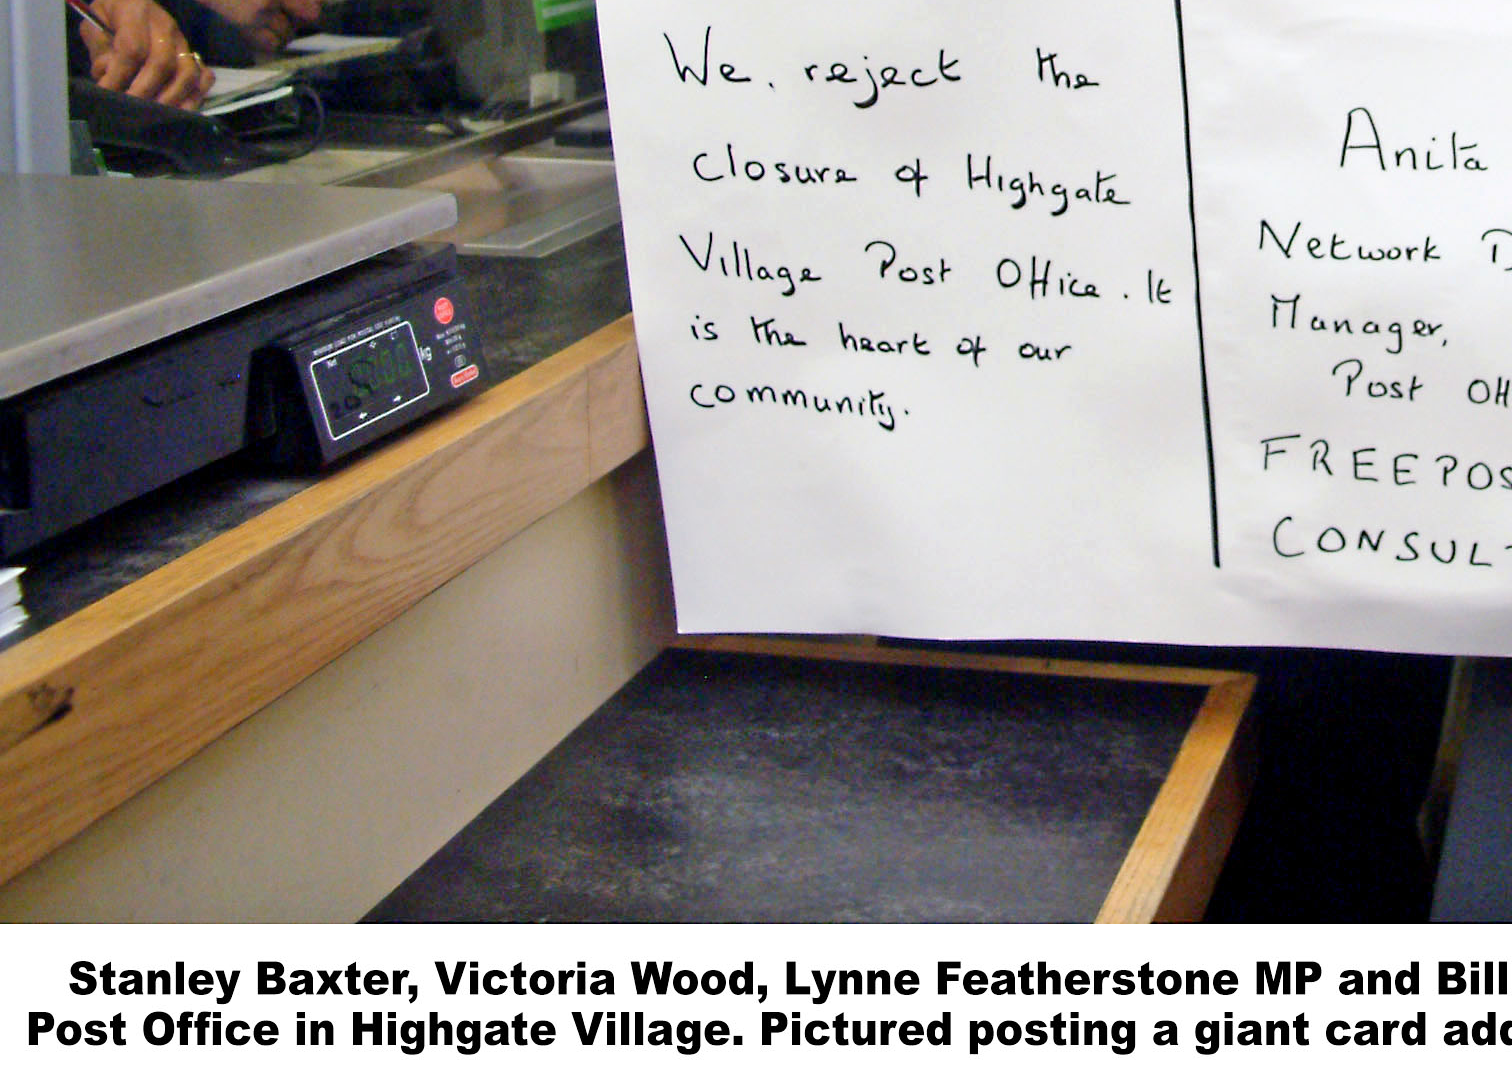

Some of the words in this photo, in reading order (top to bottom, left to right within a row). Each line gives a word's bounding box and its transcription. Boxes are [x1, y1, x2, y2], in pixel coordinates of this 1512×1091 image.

[804, 48, 962, 110] reject
[1035, 46, 1100, 90] the
[1339, 107, 1489, 172] Anita
[894, 157, 929, 198] of
[966, 153, 1131, 218] Highgate
[678, 231, 823, 298] Village
[864, 240, 952, 286] Post
[1147, 269, 1172, 304] It
[1258, 219, 1441, 263] Network
[690, 314, 719, 341] is
[750, 315, 808, 347] the
[838, 321, 931, 356] heart
[956, 335, 987, 368] of
[1018, 342, 1073, 362] our
[1270, 293, 1448, 355] Manager,
[689, 383, 910, 432] community.
[1331, 358, 1424, 402] Post
